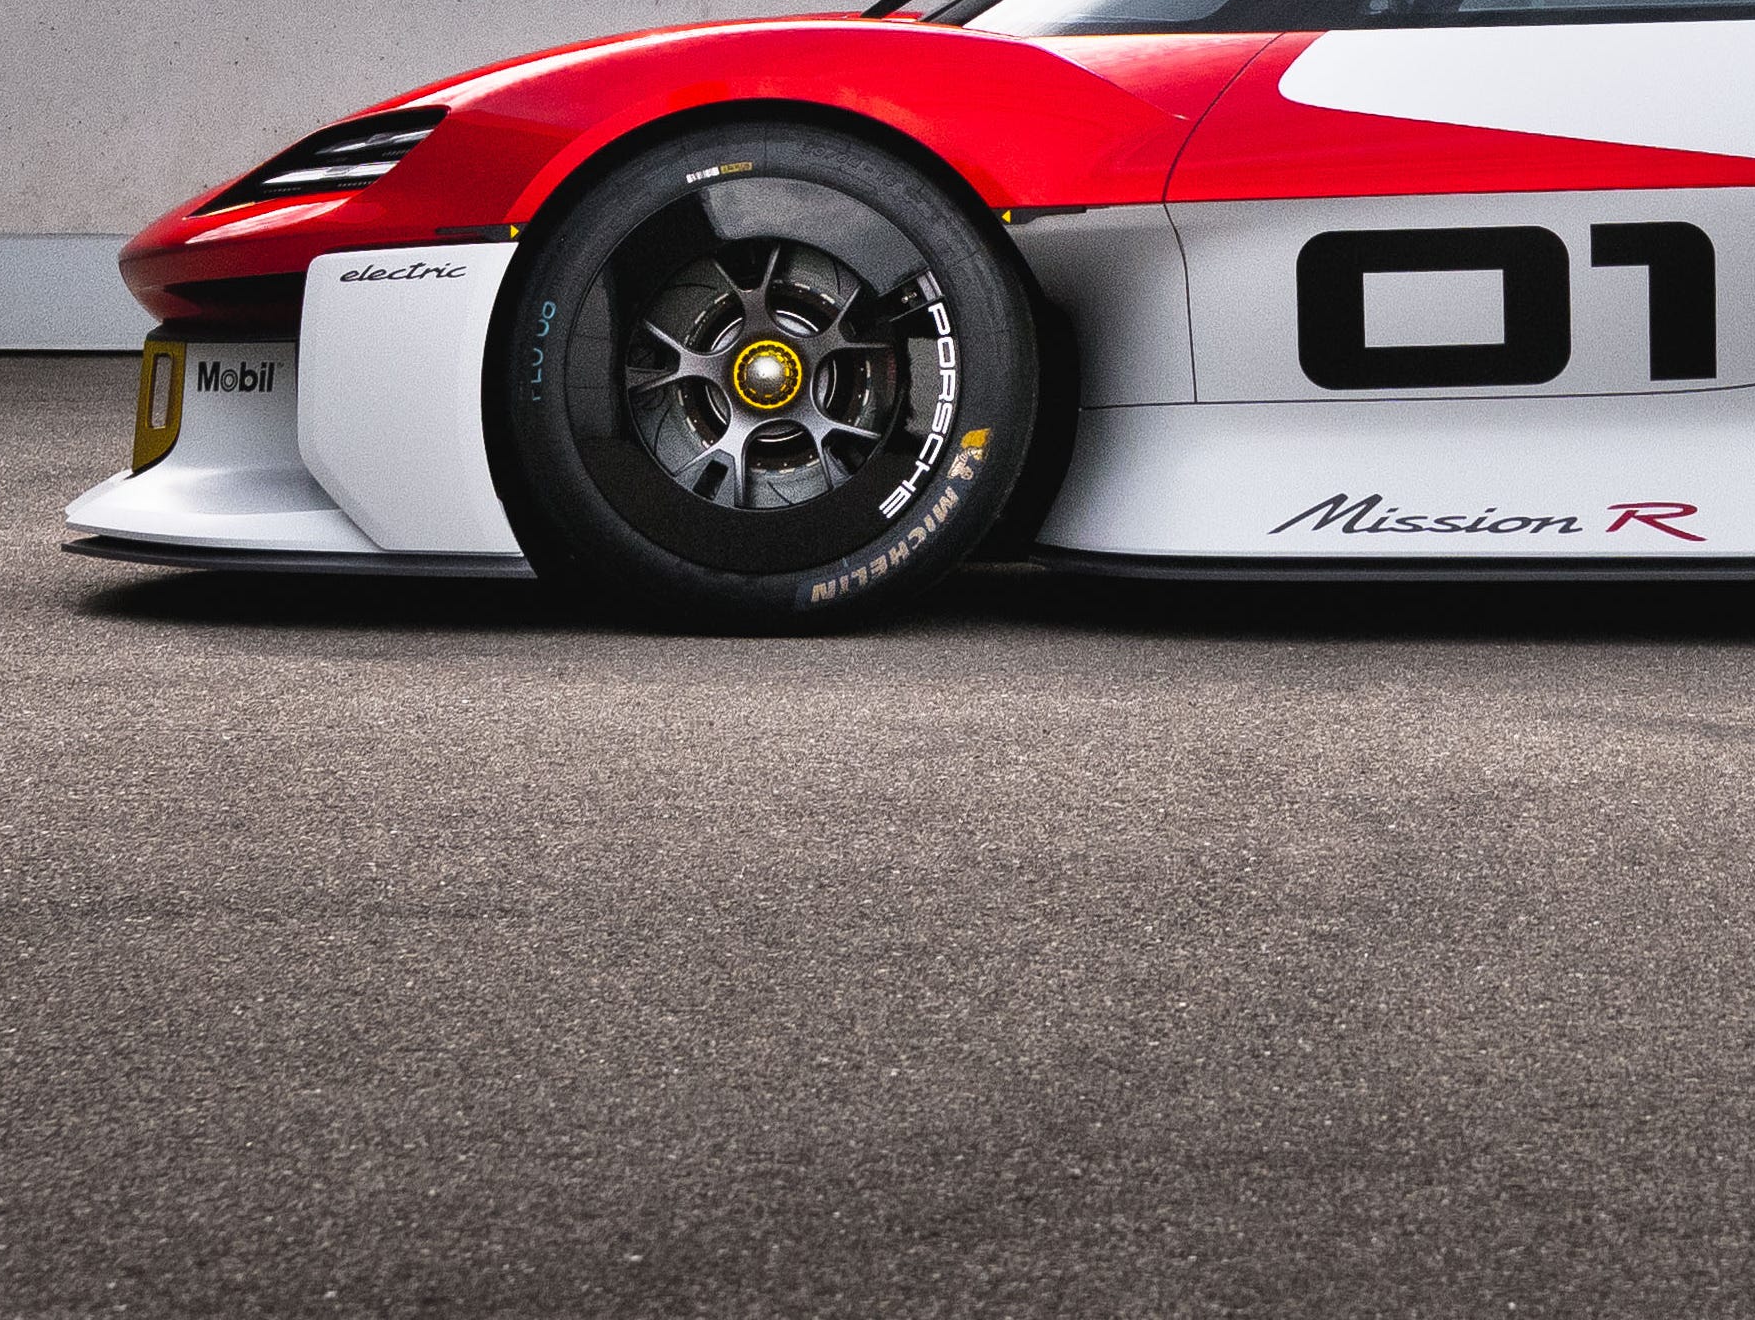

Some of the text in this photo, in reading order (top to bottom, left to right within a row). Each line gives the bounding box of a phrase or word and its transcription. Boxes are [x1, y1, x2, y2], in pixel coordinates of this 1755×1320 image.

[339, 261, 467, 283] electric
[1295, 220, 1718, 392] 01
[196, 360, 277, 393] Mobil
[878, 302, 956, 520] PORSCHE
[810, 485, 960, 603] MICHELIN
[1267, 492, 1708, 542] Mission R
